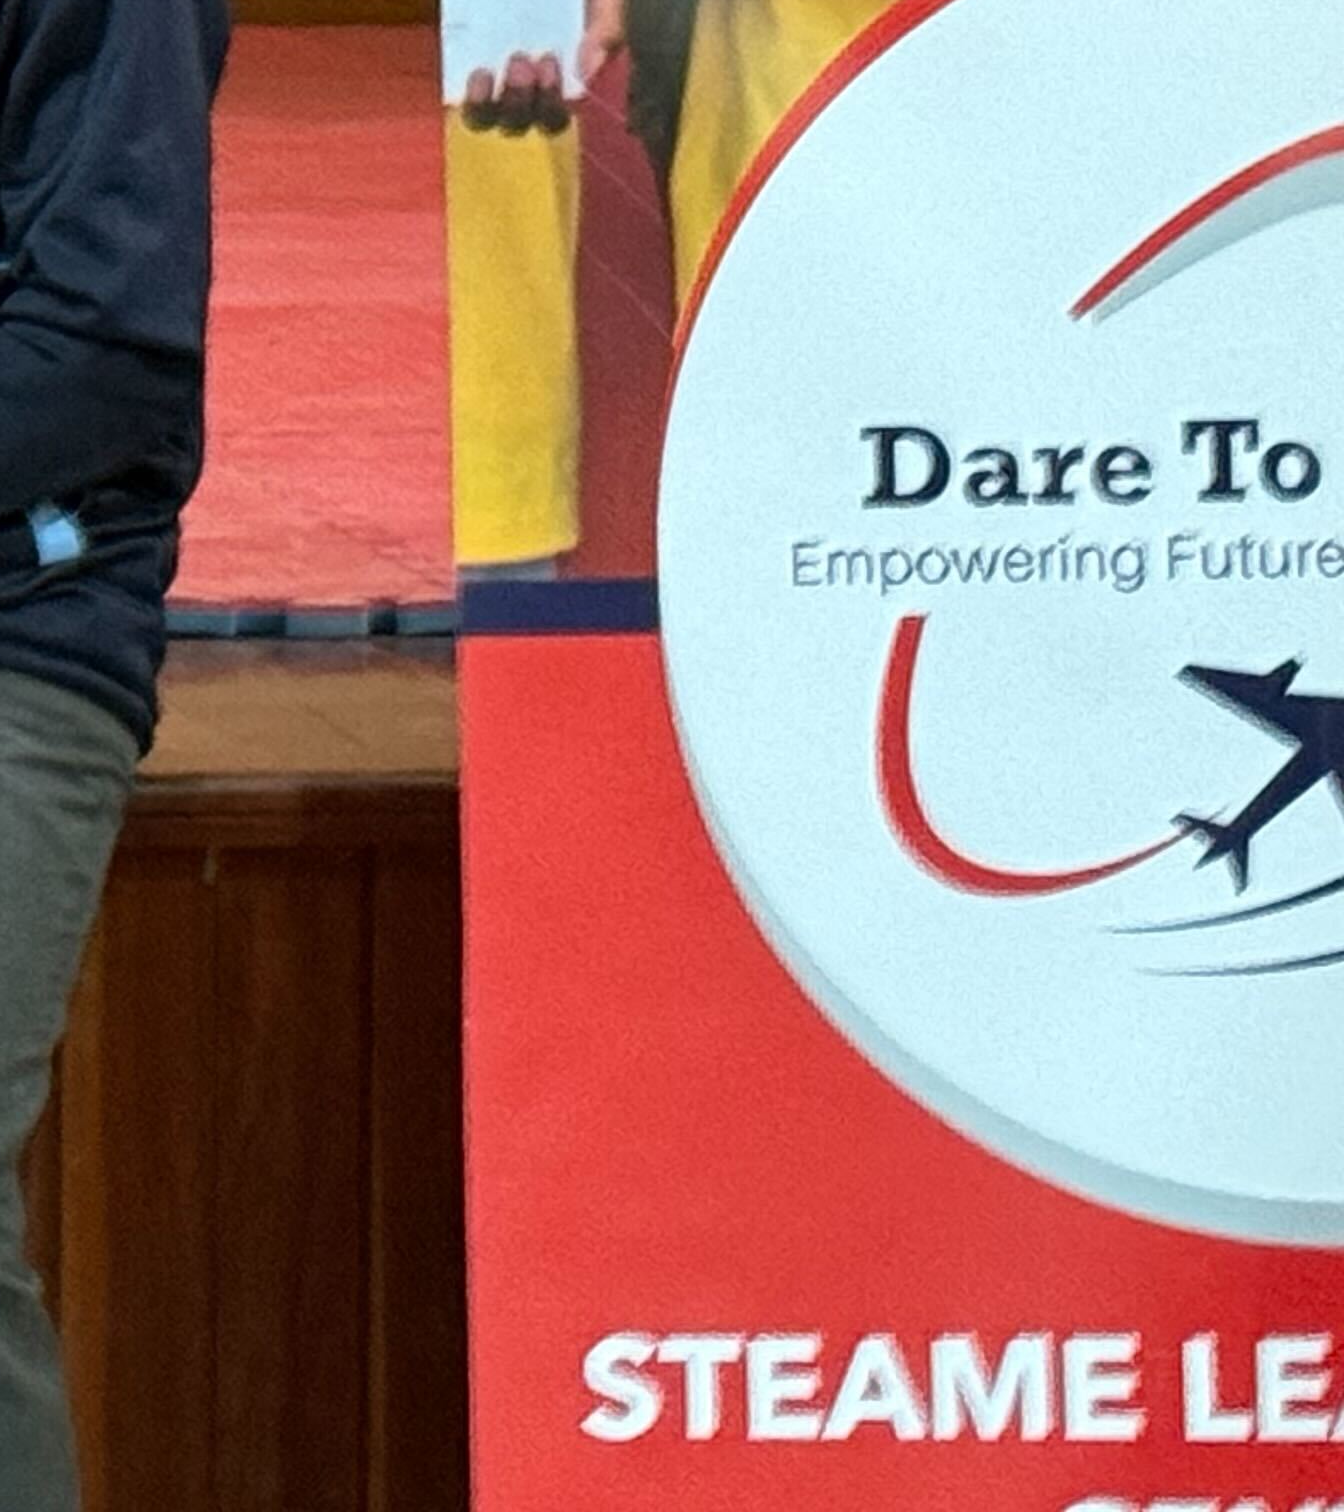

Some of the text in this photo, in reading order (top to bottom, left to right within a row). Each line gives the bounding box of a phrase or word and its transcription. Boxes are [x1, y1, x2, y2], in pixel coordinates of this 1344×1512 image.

[859, 418, 1322, 510] Dare To
[790, 532, 1344, 596] Empowering Future
[578, 1329, 1344, 1445] STEAME LE
